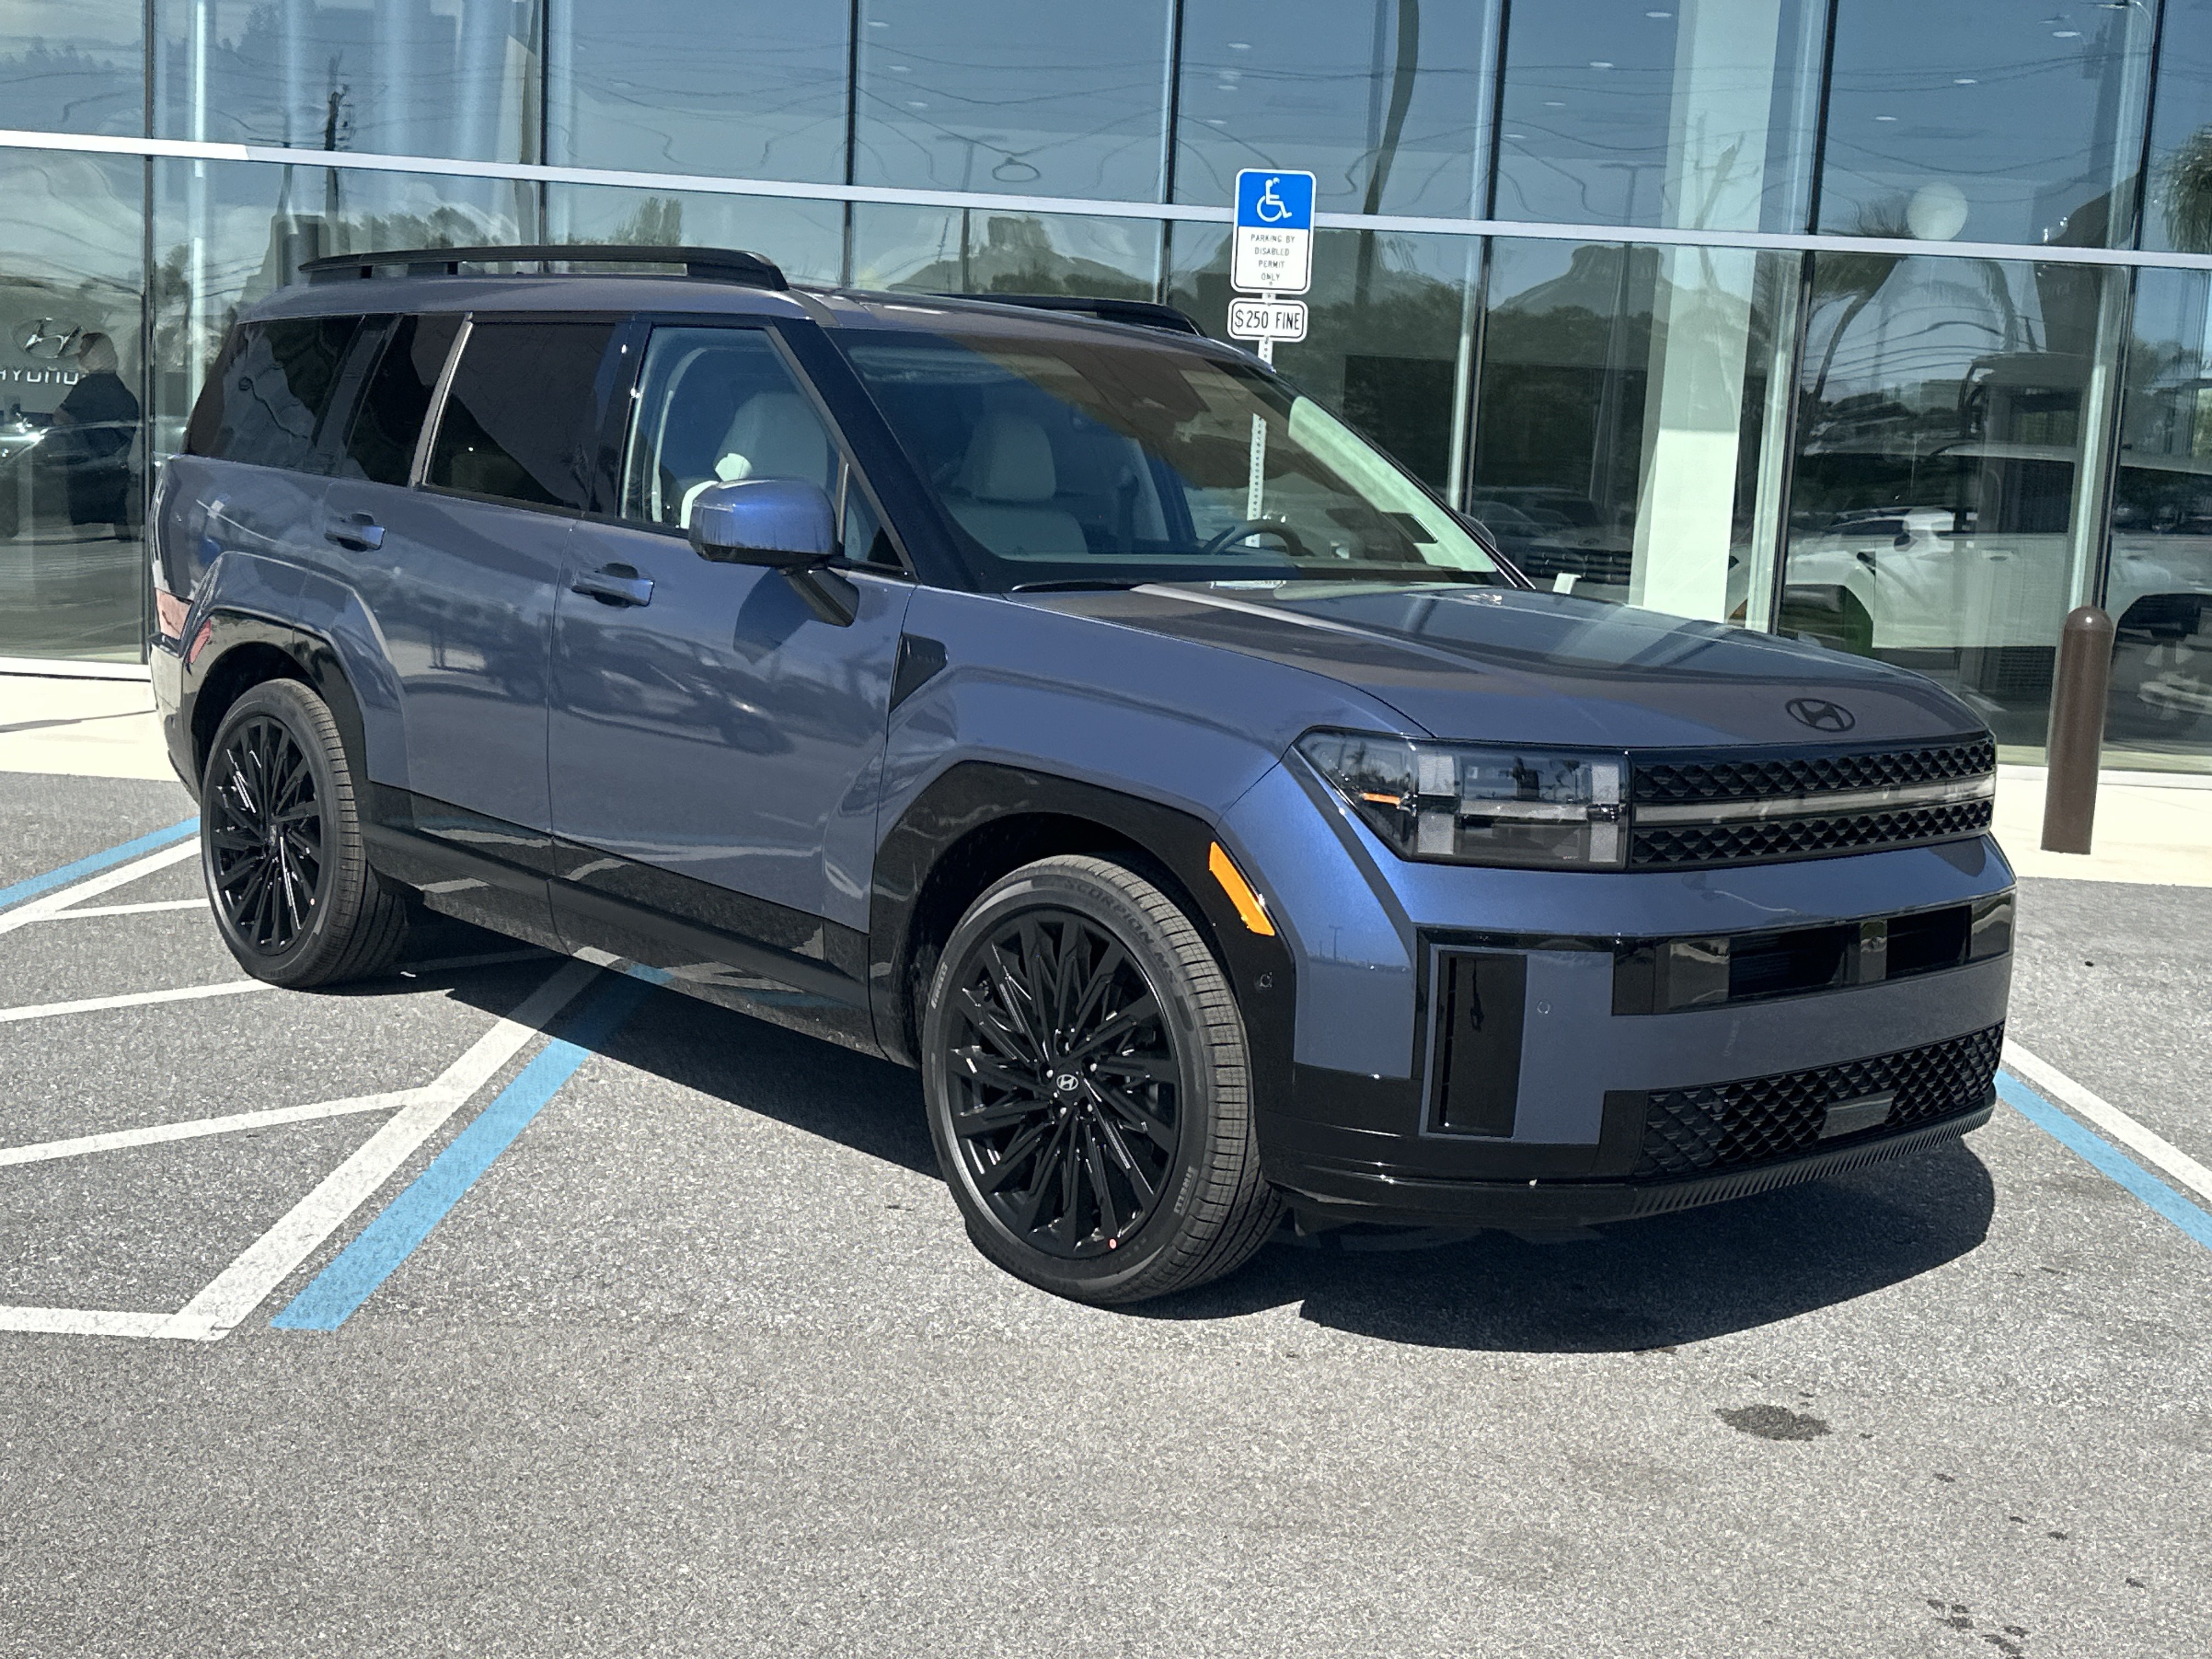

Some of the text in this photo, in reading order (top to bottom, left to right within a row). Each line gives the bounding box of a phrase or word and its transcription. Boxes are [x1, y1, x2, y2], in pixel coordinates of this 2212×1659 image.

[1251, 234, 1282, 242] PARKING
[1255, 247, 1290, 256] DISABLED
[1259, 260, 1285, 268] PERMIT
[1234, 309, 1301, 330] $250 FINE
